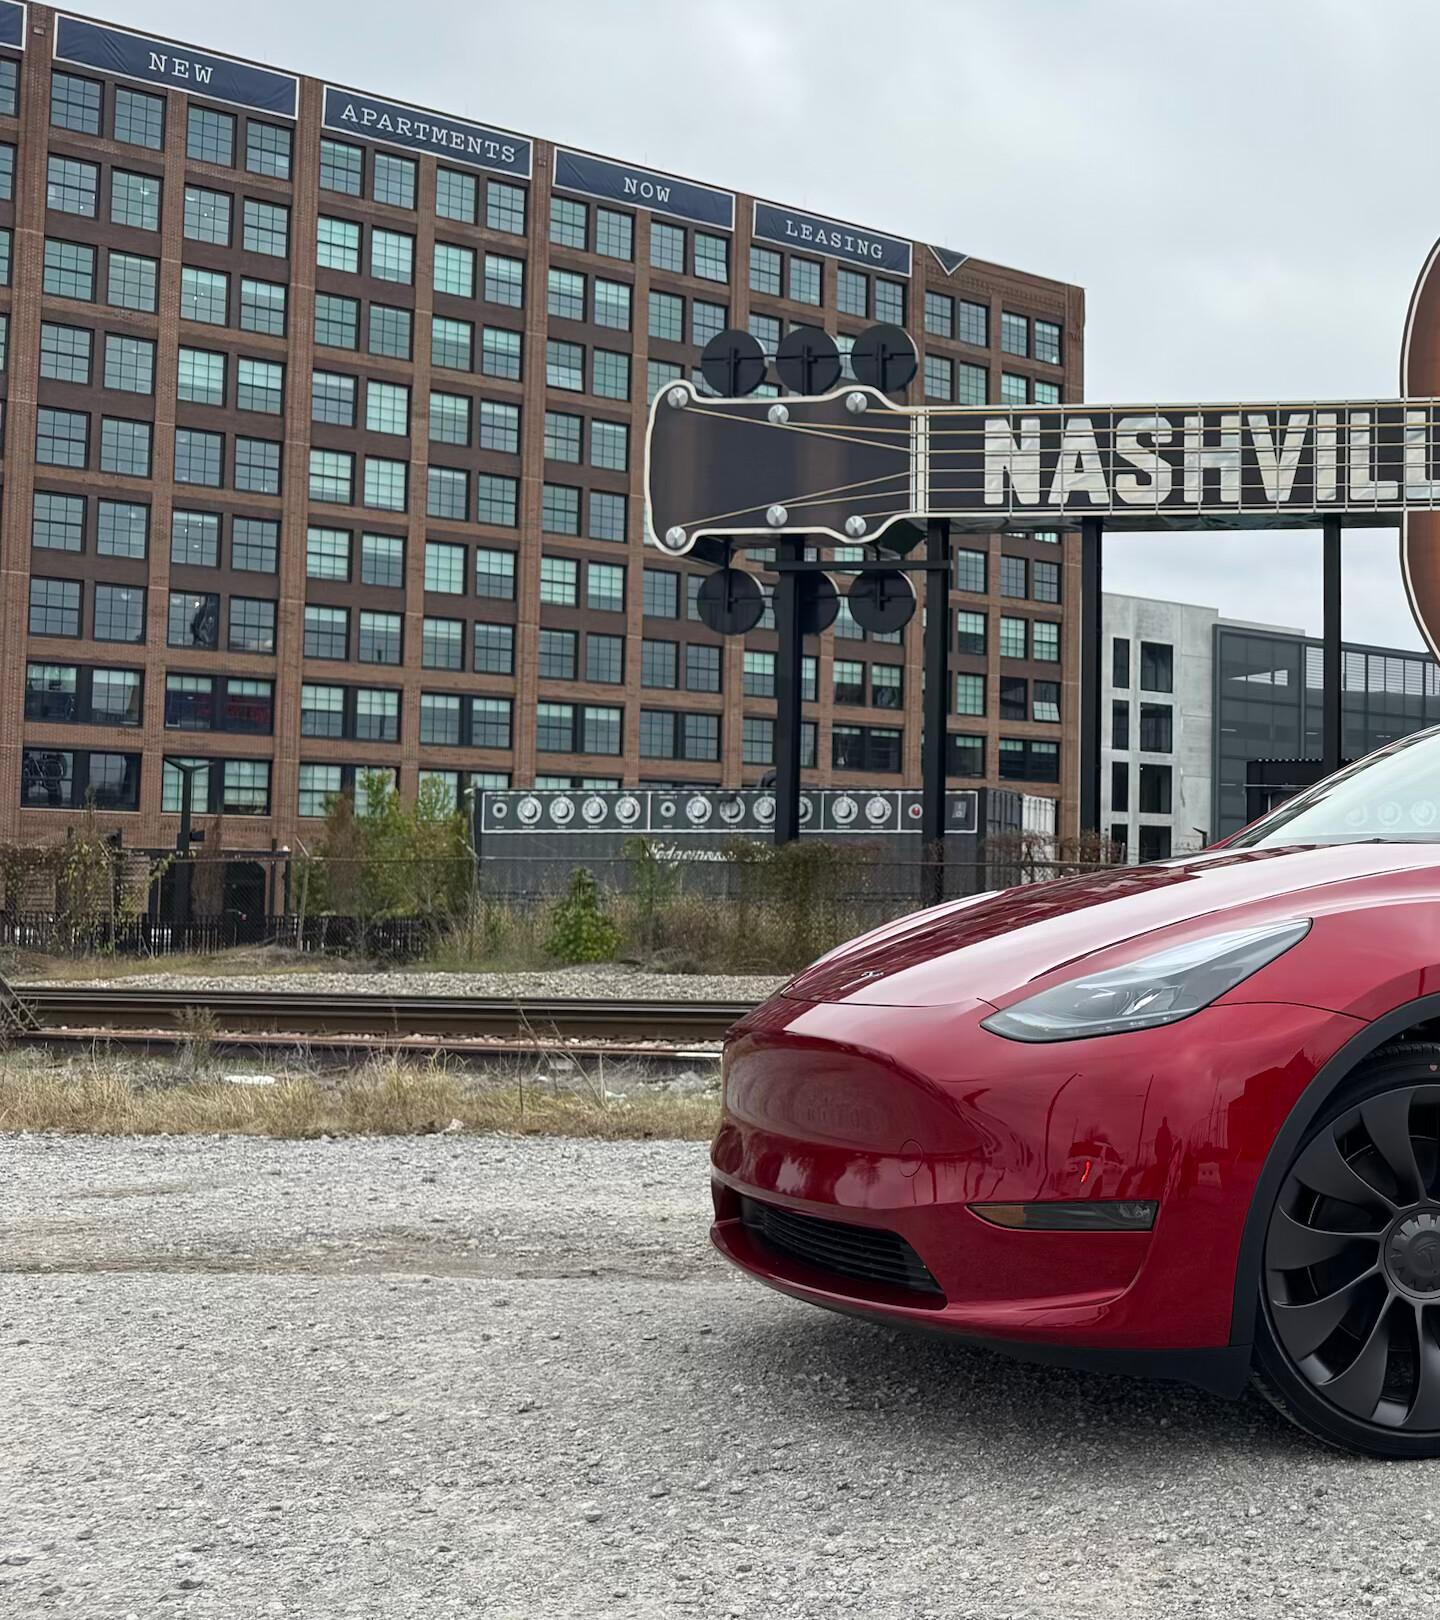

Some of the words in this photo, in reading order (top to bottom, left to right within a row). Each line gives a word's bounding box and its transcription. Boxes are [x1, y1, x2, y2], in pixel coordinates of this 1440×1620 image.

[149, 52, 213, 84] NEW
[340, 103, 515, 163] APARTMENTS
[623, 176, 671, 202] NOW
[785, 220, 883, 259] LEASING
